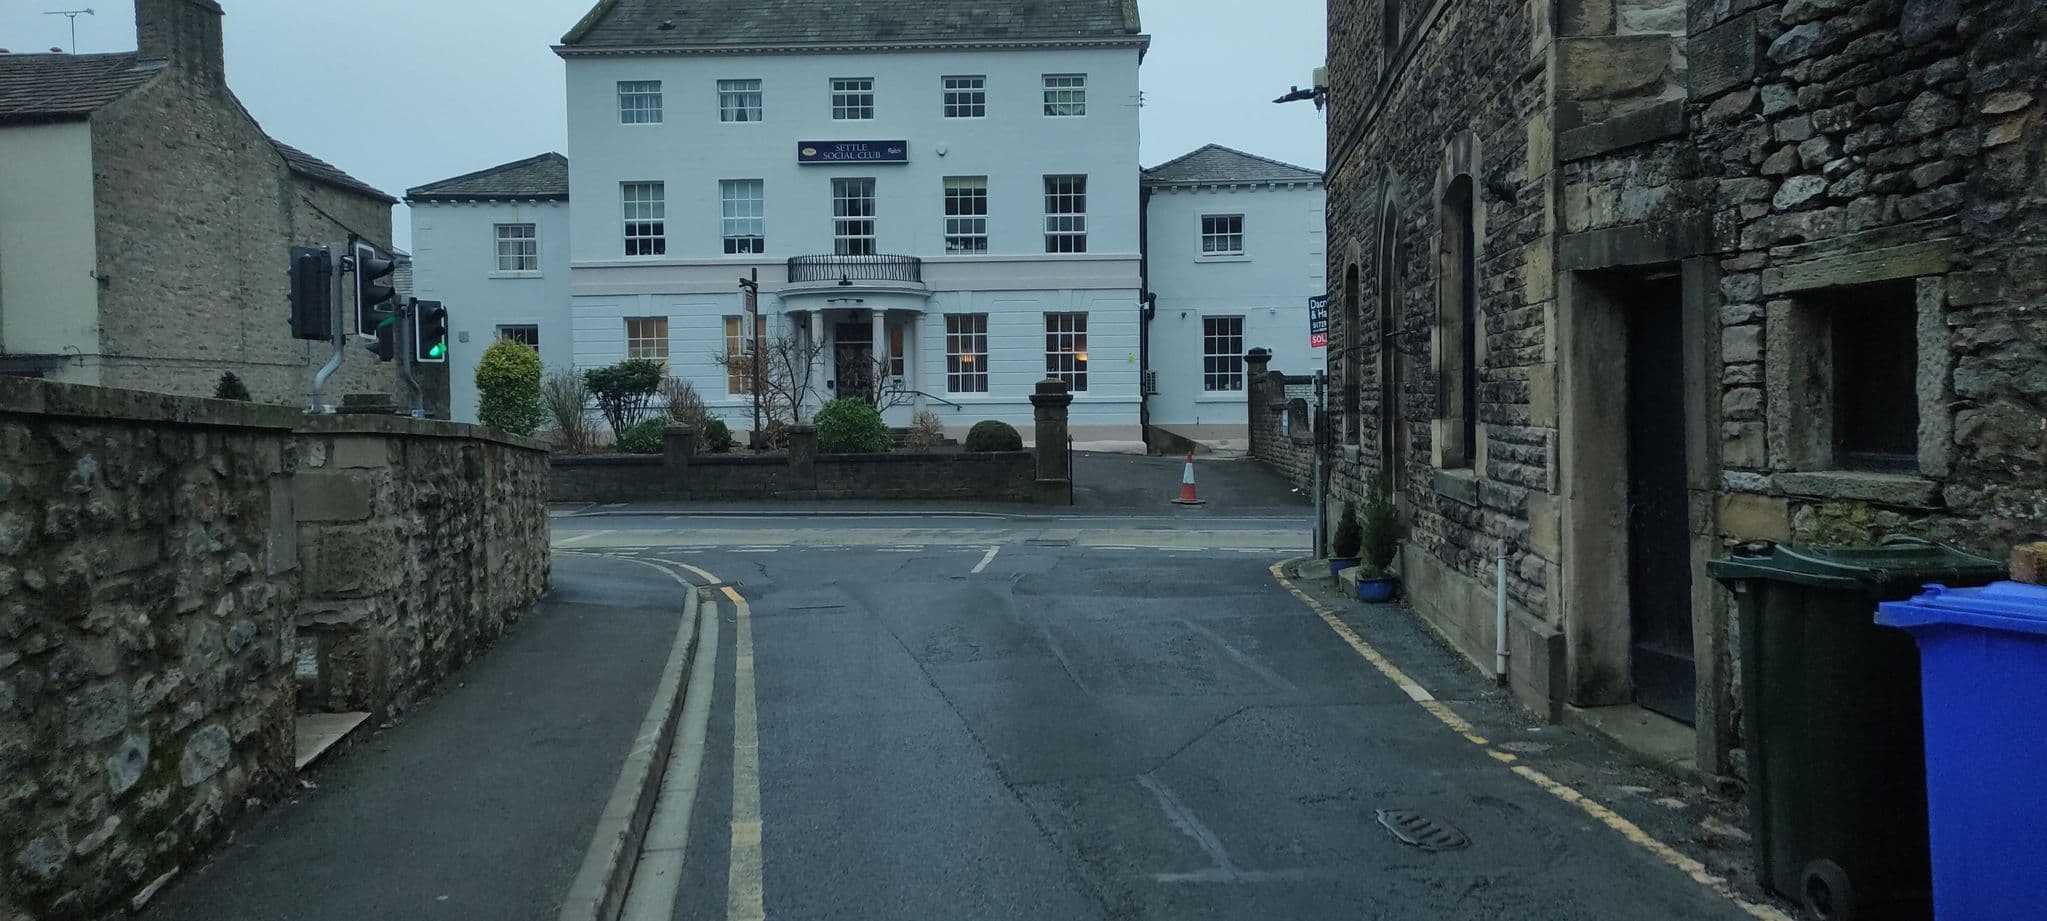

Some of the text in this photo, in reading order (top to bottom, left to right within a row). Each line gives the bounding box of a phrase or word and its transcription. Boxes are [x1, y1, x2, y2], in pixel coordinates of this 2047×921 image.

[835, 143, 867, 152] SETTLE
[823, 151, 855, 160] SOCIAL
[857, 151, 881, 160] CLUB
